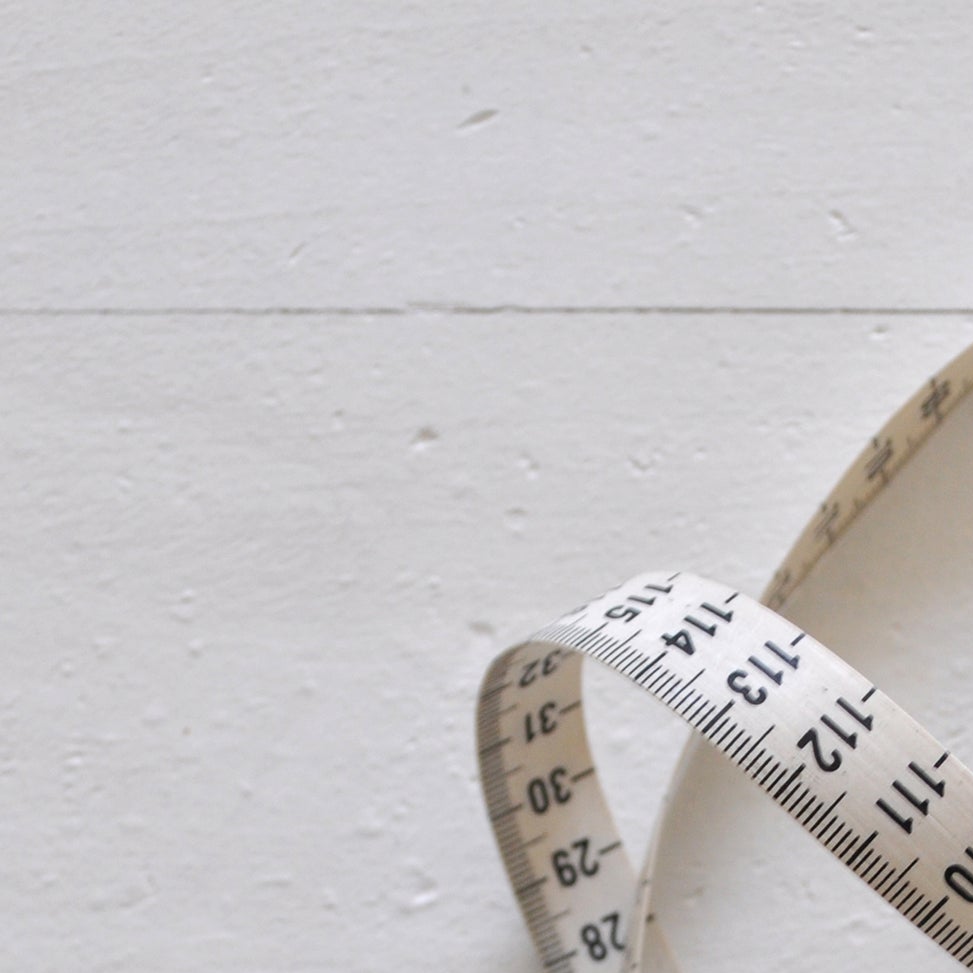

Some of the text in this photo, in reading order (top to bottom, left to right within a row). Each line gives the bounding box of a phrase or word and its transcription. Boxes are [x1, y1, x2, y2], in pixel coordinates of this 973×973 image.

[605, 583, 674, 622] 115
[661, 601, 734, 656] 114
[518, 649, 561, 688] 32
[726, 640, 801, 706] 113
[524, 701, 558, 742] 31
[796, 697, 874, 772] 112
[526, 767, 572, 815] 30
[875, 761, 946, 834] 111
[552, 838, 600, 887] 29
[580, 912, 626, 961] 28
